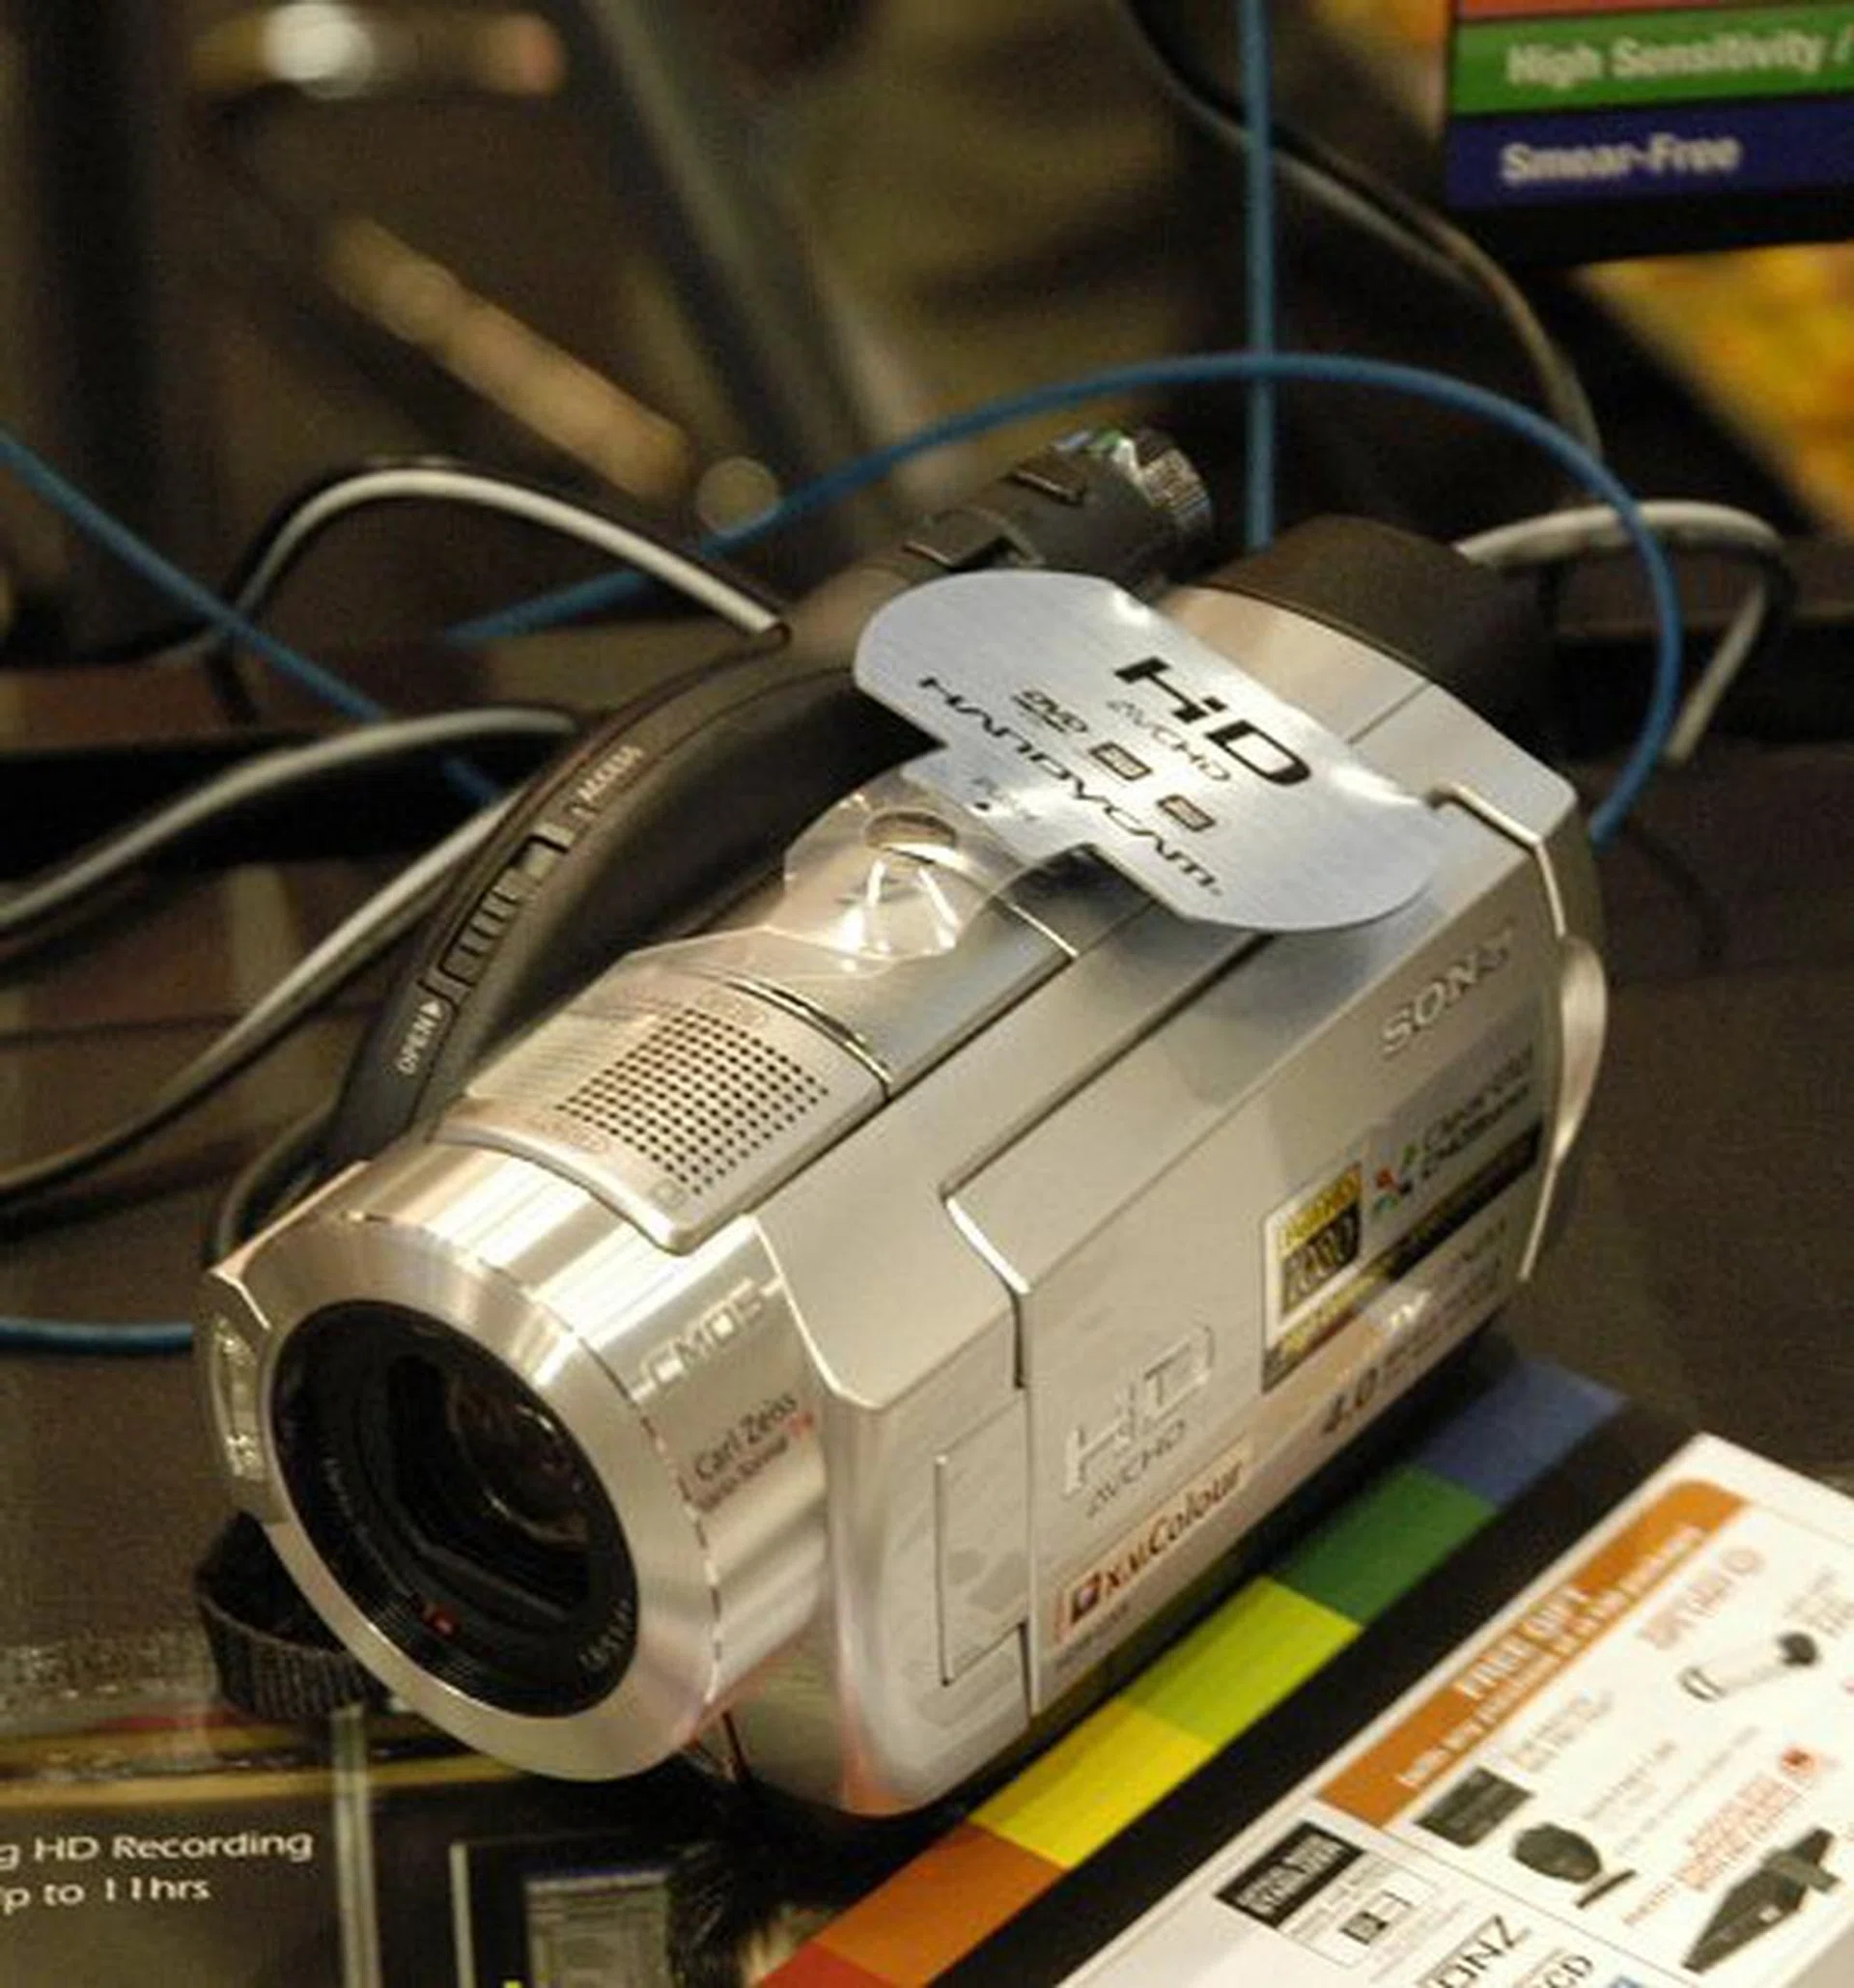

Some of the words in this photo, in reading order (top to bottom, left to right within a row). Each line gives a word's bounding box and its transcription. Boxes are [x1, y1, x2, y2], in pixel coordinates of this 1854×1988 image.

[1506, 43, 1603, 90] High
[1612, 30, 1825, 79] Sensitivity
[1502, 132, 1743, 185] Smear-Free
[1105, 698, 1232, 782] AVCHD
[1114, 657, 1312, 786] HD
[1382, 922, 1513, 1054] SONY
[398, 1014, 435, 1075] OPEN
[694, 1429, 743, 1480] Carl
[740, 1392, 799, 1445] Zeiss
[34, 1835, 100, 1862] HD
[111, 1832, 314, 1863] Recording
[43, 1884, 86, 1907] to
